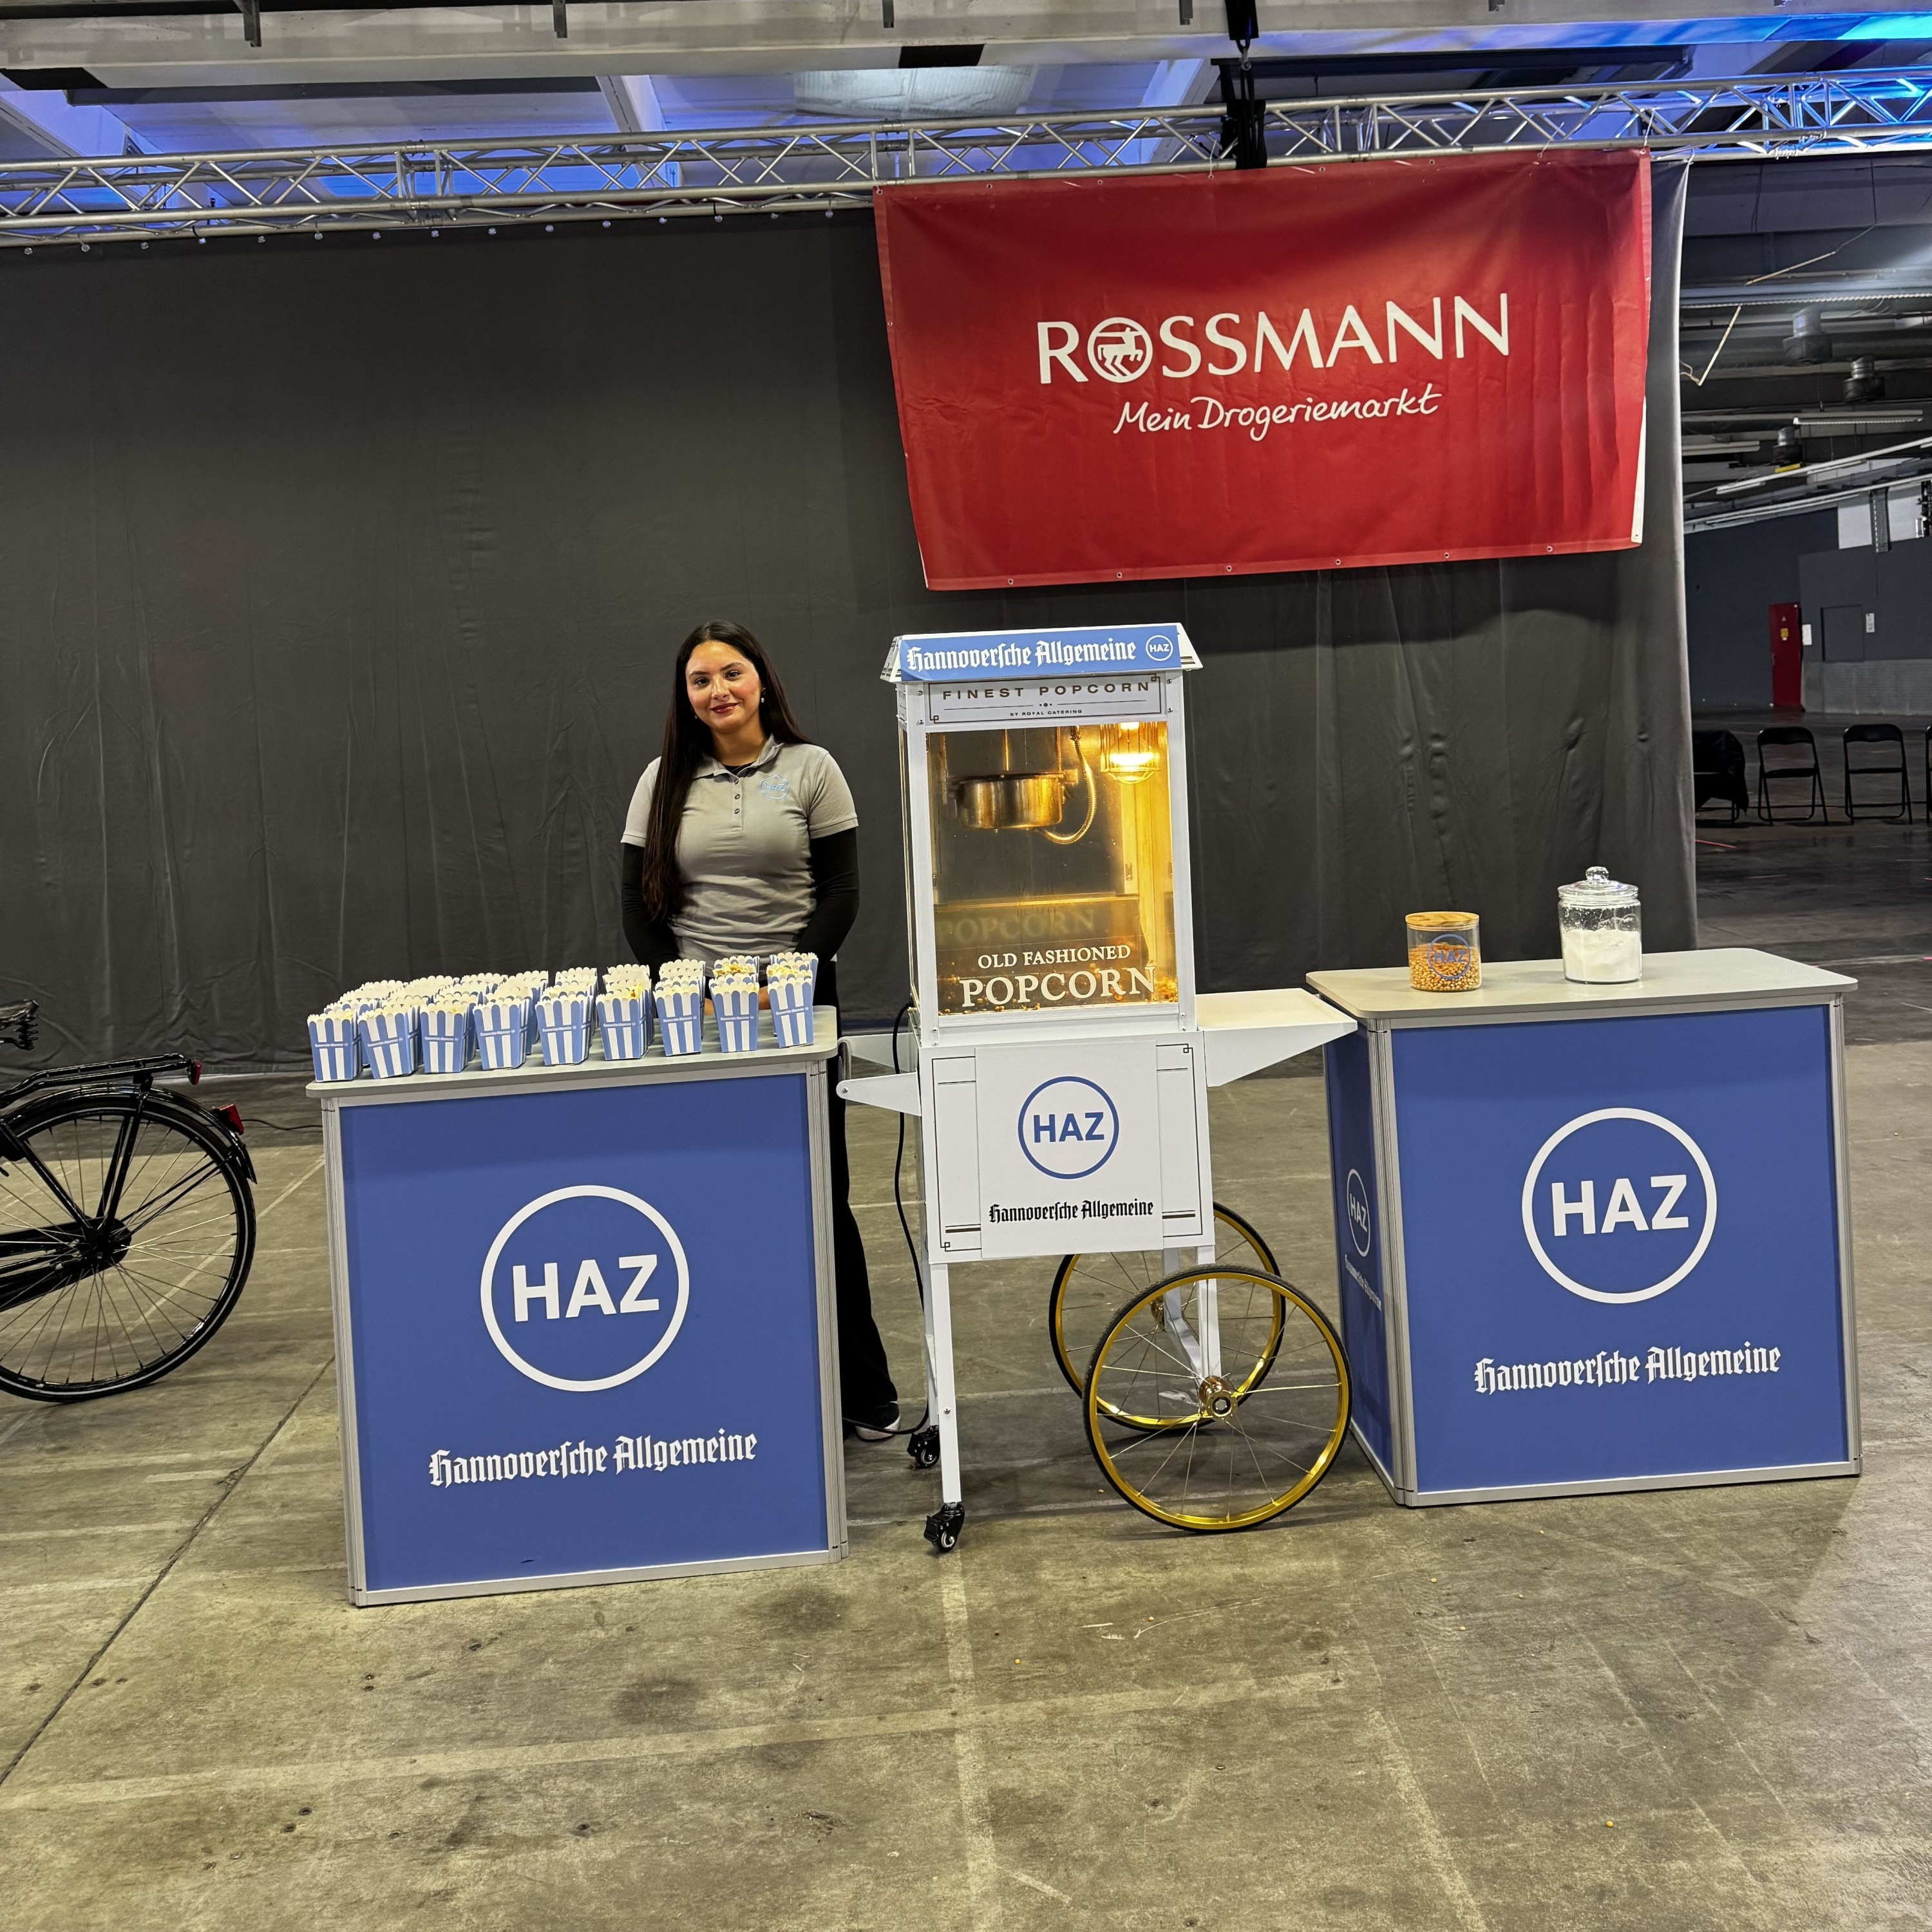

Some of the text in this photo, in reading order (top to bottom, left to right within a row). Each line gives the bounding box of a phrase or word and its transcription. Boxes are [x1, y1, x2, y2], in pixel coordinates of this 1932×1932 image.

[1037, 293, 1509, 384] ROSSMANN
[1113, 383, 1443, 442] Mein Drogeriemarkt
[1034, 638, 1137, 667] Allgemeine
[1149, 643, 1170, 653] HAZ
[943, 682, 1150, 700] FINEST POPCORN
[978, 944, 1132, 969] OLD FASHIONED
[1434, 949, 1465, 964] HAZ
[960, 965, 1157, 1007] POPCORN
[1033, 1112, 1105, 1143] HAZ
[1081, 1198, 1154, 1220] Allgemeine
[1350, 1193, 1368, 1233] HAZ
[1551, 1174, 1689, 1236] HAZ
[513, 1254, 659, 1322] HAZ
[1645, 1341, 1781, 1384] Allgemeine
[612, 1428, 757, 1474] Allgemeine
